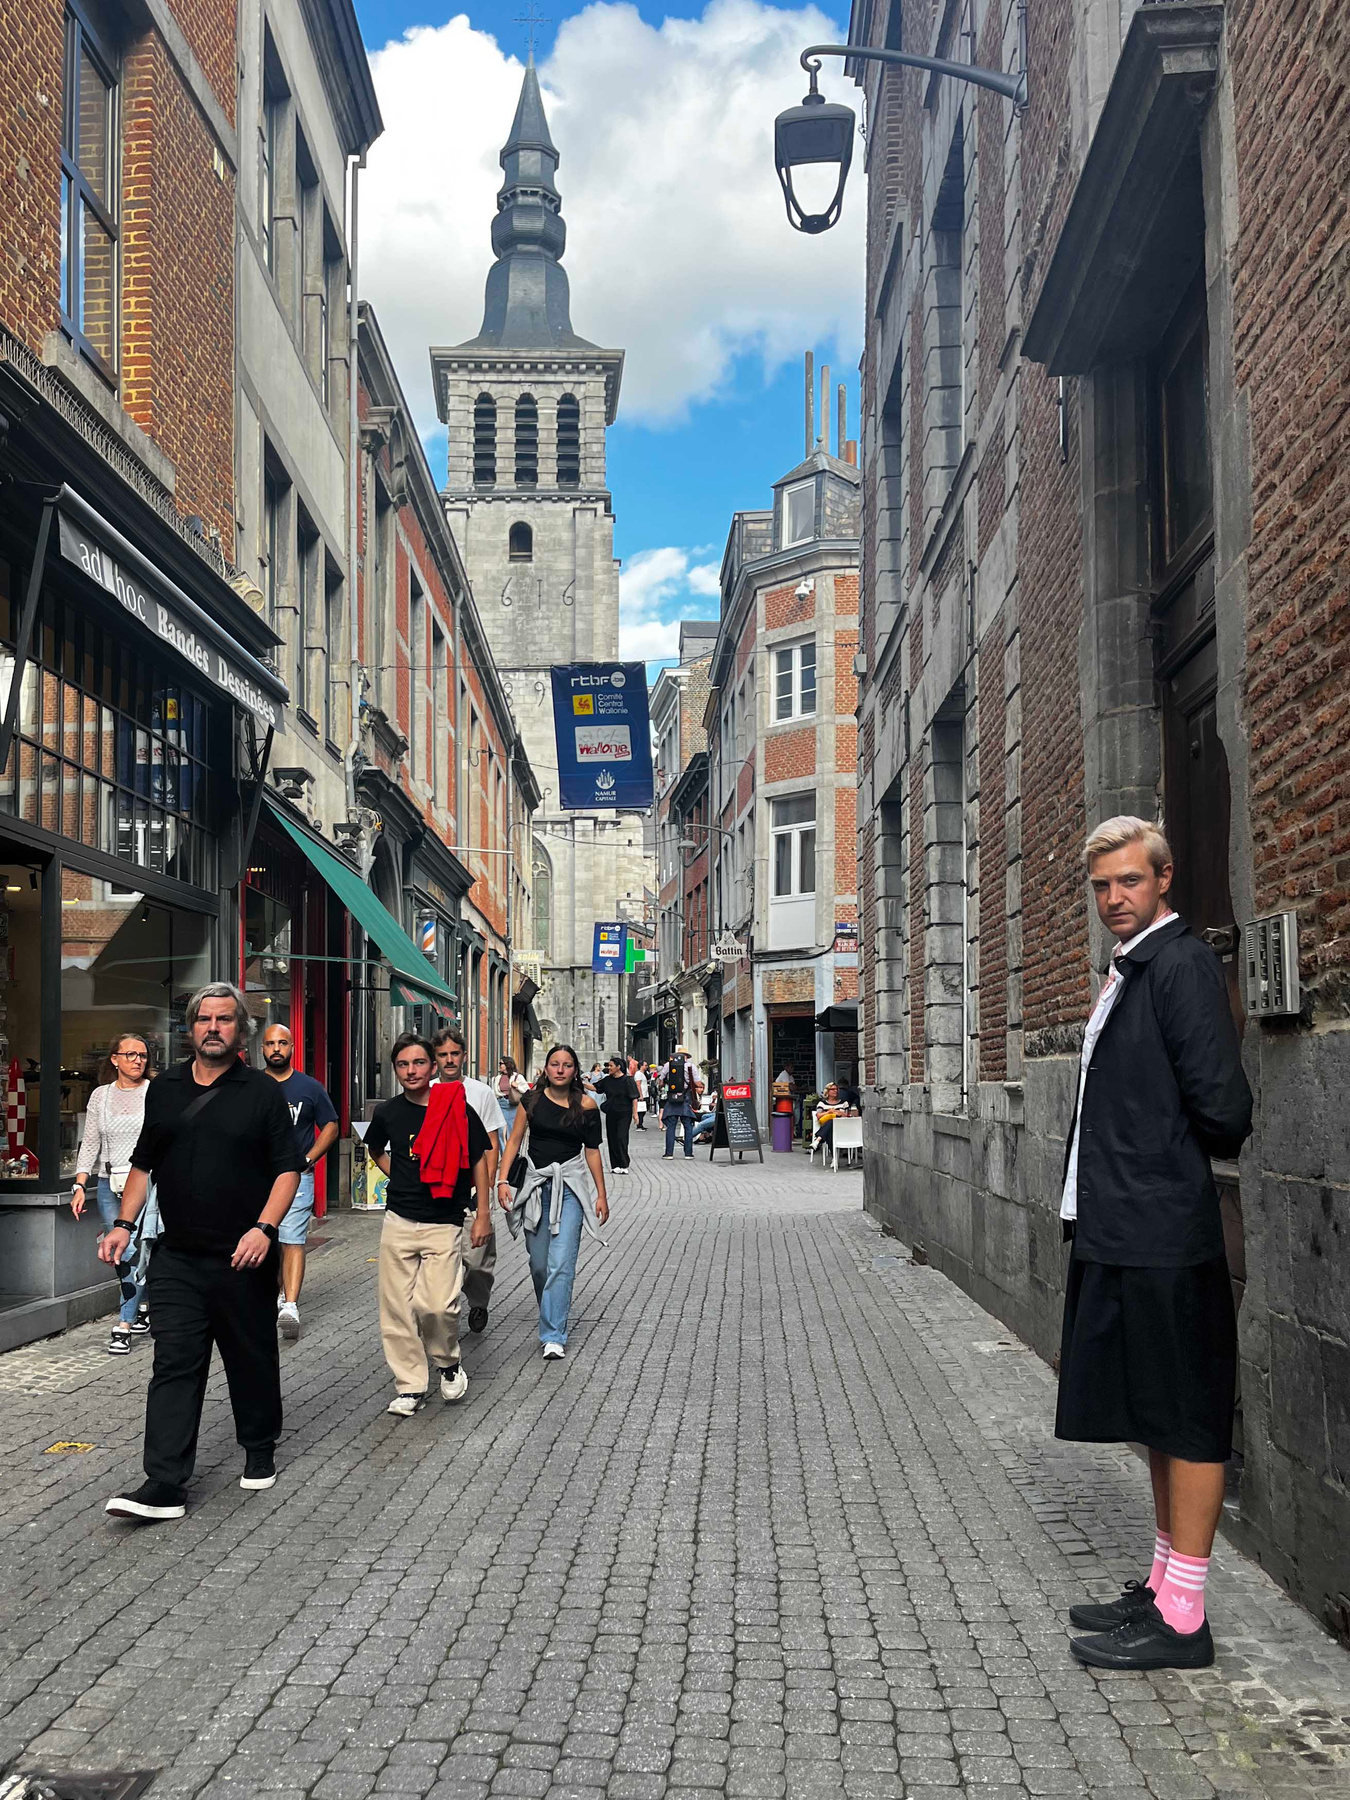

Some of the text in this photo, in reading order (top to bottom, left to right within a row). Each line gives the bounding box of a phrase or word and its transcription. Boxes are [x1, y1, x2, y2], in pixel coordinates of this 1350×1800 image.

[79, 543, 276, 725] ad hoc Bandes Dessinées
[597, 692, 623, 700] Comité
[598, 706, 629, 715] Wallonie
